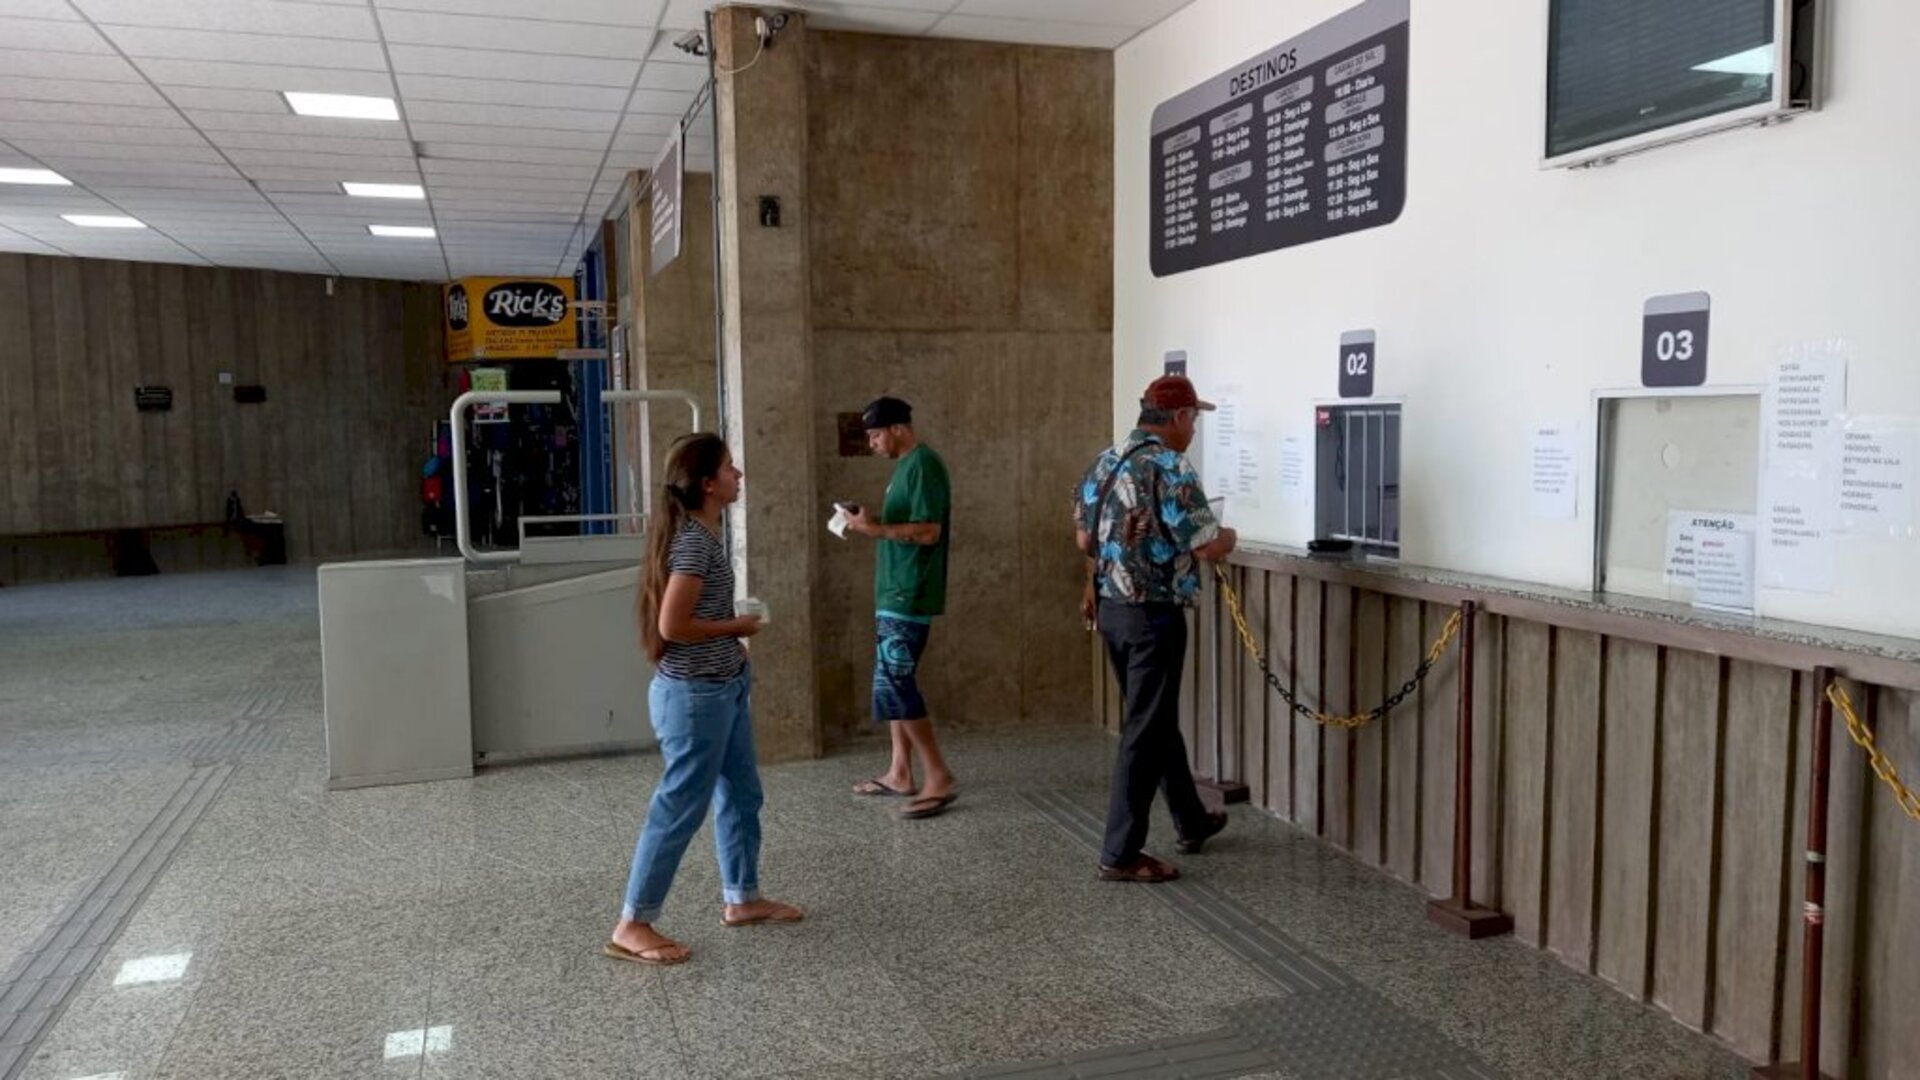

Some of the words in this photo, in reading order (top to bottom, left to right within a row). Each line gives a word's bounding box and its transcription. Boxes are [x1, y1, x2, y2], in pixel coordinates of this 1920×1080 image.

[1230, 48, 1297, 96] DESTINOS
[489, 288, 565, 318] Rick's
[1657, 329, 1694, 361] 03
[1346, 353, 1368, 376] 02
[1691, 518, 1736, 531] ATENÇÃO
